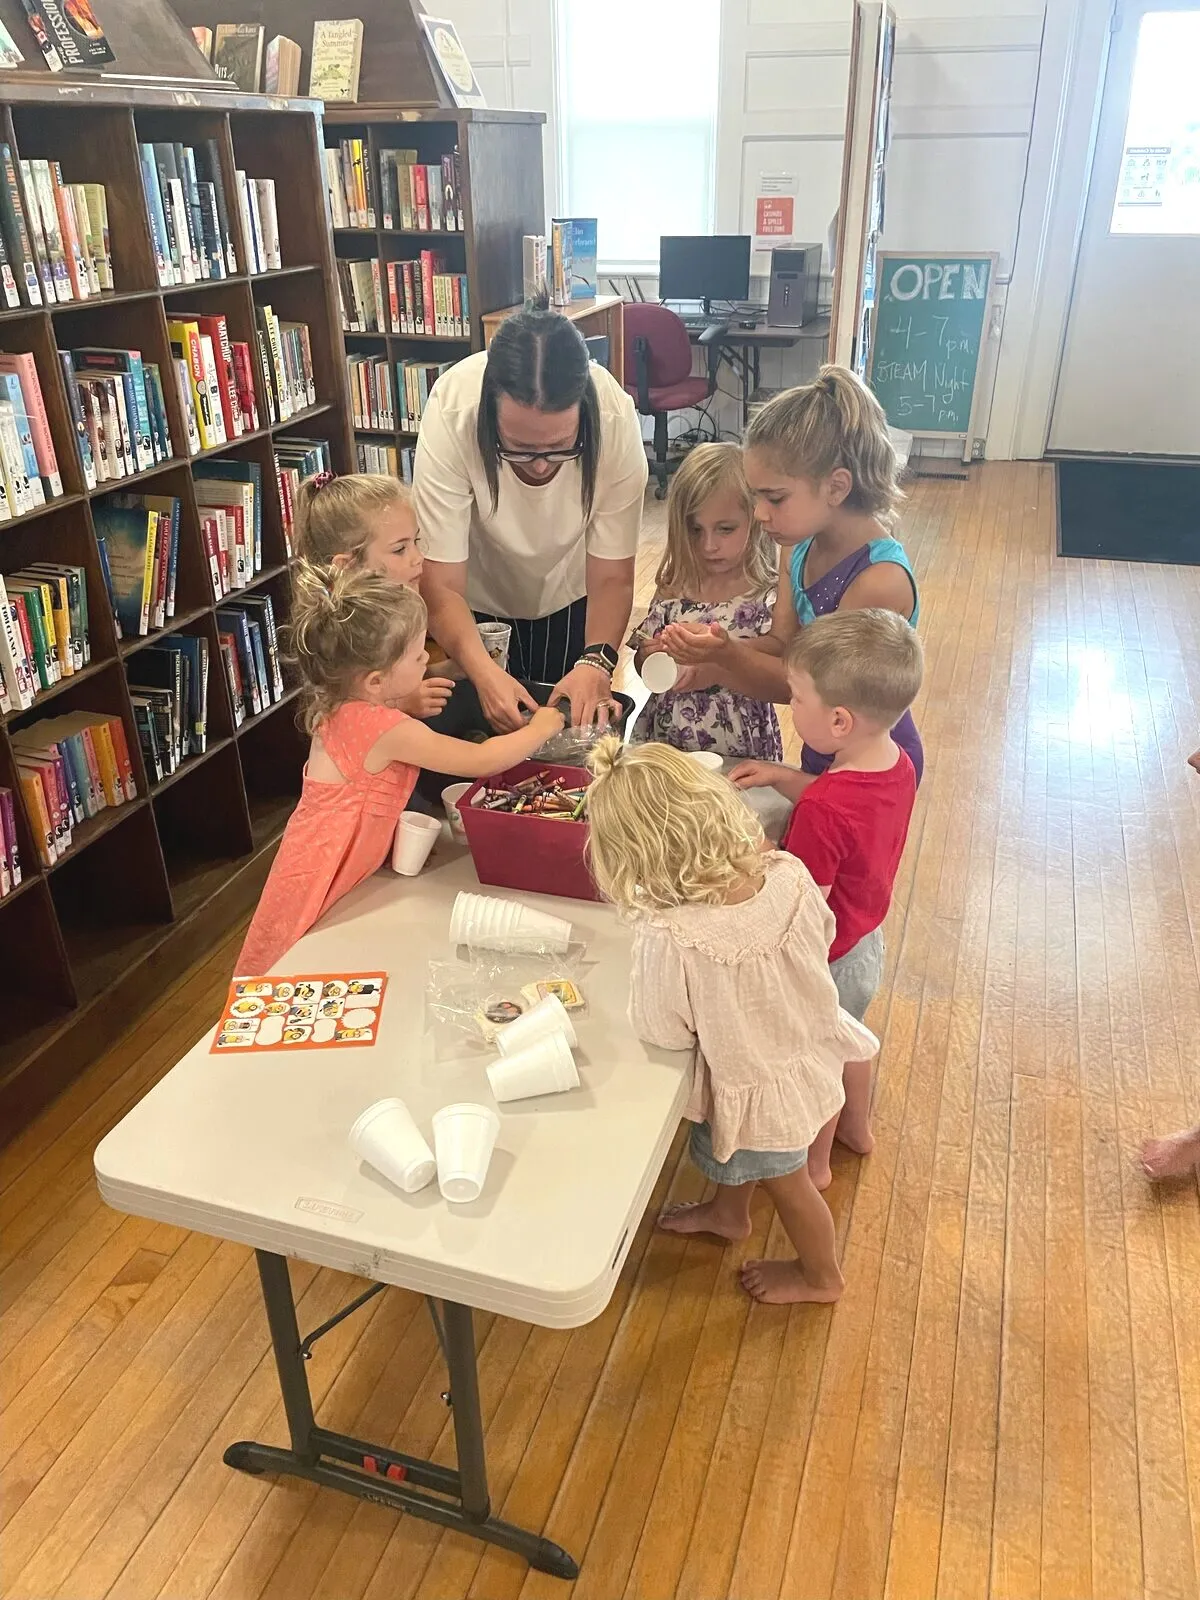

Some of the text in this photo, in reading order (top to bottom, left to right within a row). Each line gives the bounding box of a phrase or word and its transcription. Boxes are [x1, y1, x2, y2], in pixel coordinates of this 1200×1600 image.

[321, 40, 349, 48] Summer
[328, 29, 352, 39] Tangled
[57, 46, 68, 64] THE
[10, 190, 23, 217] PIRATE
[890, 264, 987, 300] OPEN
[191, 339, 201, 377] CHABON
[218, 321, 231, 363] MATCHUP
[228, 386, 236, 399] LEE
[271, 338, 279, 358] CHILD
[877, 360, 970, 404] STEAM Night
[30, 371, 38, 393] SCHOOL
[43, 427, 51, 452] MOTHERS
[1, 606, 18, 657] TOM CLANCY
